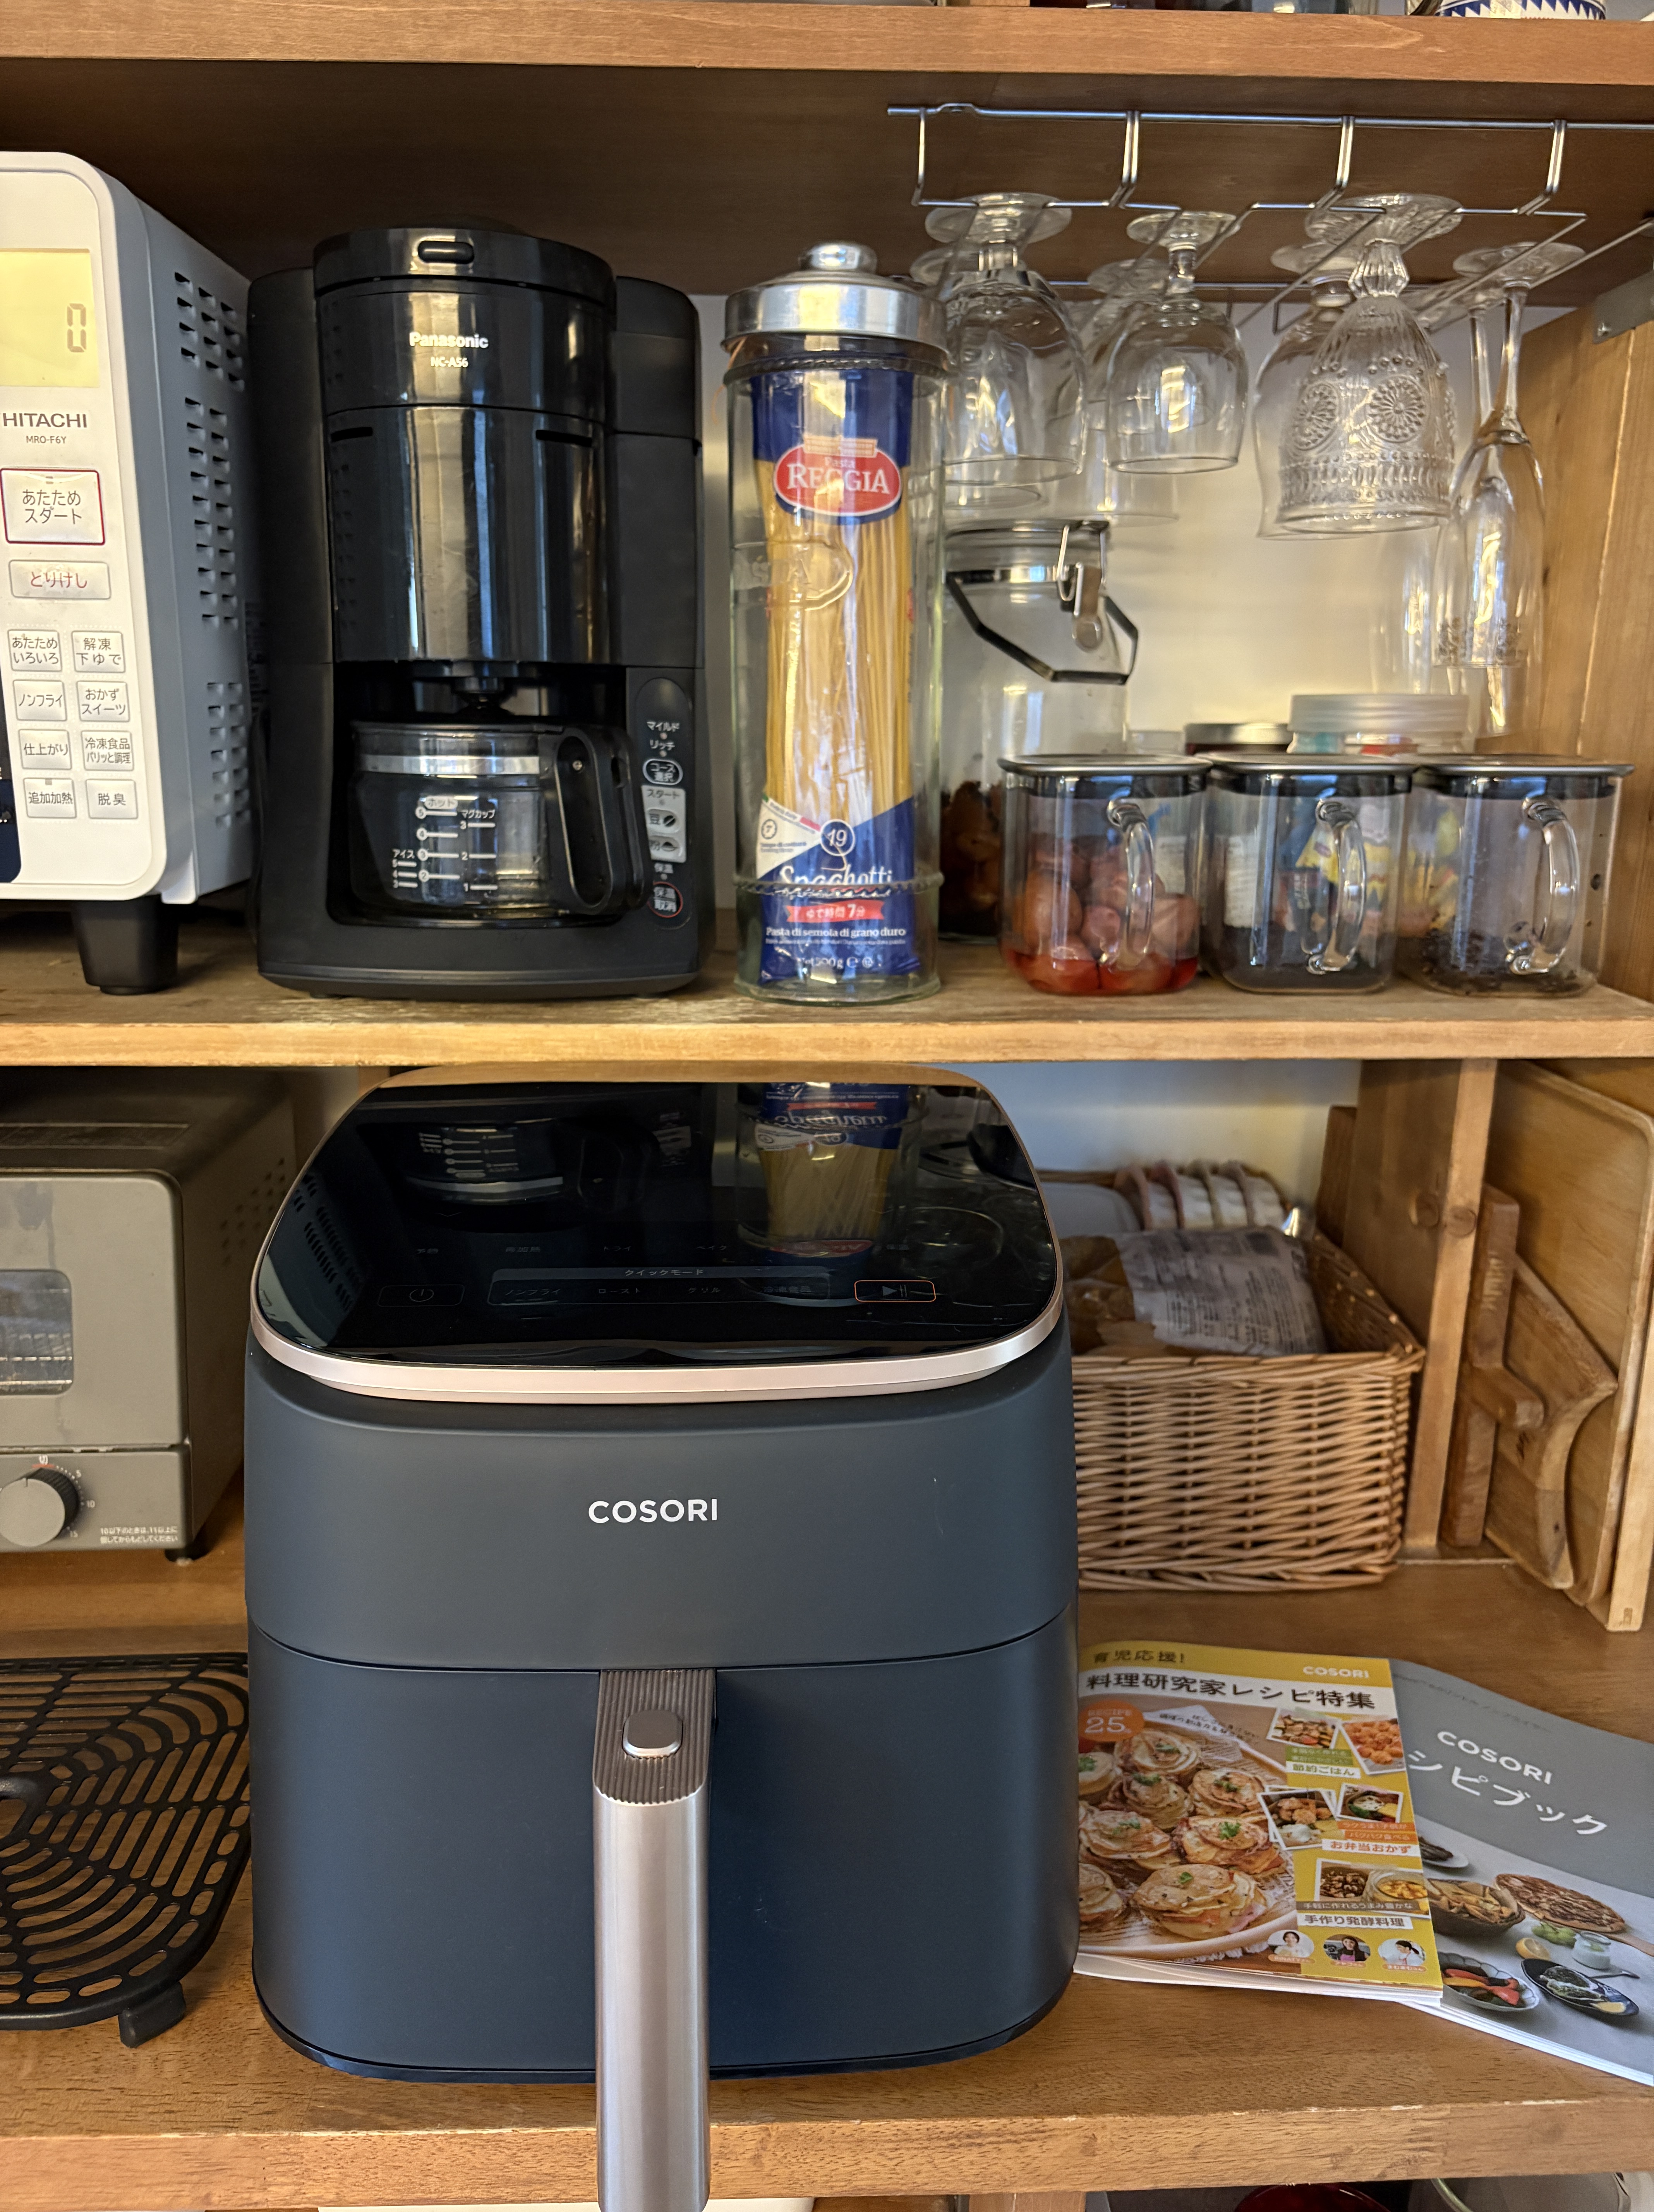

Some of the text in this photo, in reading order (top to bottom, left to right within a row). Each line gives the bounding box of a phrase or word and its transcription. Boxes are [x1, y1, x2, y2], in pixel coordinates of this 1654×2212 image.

[67, 303, 86, 352] 0
[410, 331, 489, 349] Panasonic
[431, 356, 468, 368] NC-A56
[3, 413, 87, 428] HITACHI
[26, 435, 66, 444] MRO-F6Y
[787, 463, 890, 495] REGGIA
[22, 490, 81, 507] あたため
[25, 508, 82, 524] スタート
[30, 572, 88, 588] とりけし
[12, 637, 57, 649] あたため
[84, 638, 111, 650] 解凍
[13, 652, 59, 664] いろいろ
[76, 653, 121, 665] 下ゆで
[19, 694, 62, 707] ノンフライ
[85, 689, 119, 701] おかず
[82, 704, 125, 715] スイーツ
[24, 743, 68, 756] 仕上がり
[85, 737, 130, 750] 冷凍食品
[650, 763, 676, 773] コース
[28, 791, 73, 804] 追加加熱
[98, 793, 126, 806] 脱臭
[647, 789, 679, 799] スタート
[428, 799, 455, 807] ホット
[461, 809, 495, 819] マグカップ
[460, 820, 467, 830] 3
[825, 829, 847, 847] 19
[461, 852, 468, 860] 2
[463, 883, 468, 891] 1
[766, 927, 906, 939] Pasta di semola di grano duro
[625, 1268, 703, 1276] クイックモード
[505, 1288, 561, 1296] ノンフライ
[86, 1500, 95, 1508] 10
[588, 1499, 717, 1523] COSORI
[1302, 1666, 1369, 1679] COSORI
[1086, 1672, 1376, 1709] 料理研究家レシピ特集
[1085, 1716, 1126, 1734] 25
[1437, 1731, 1553, 1785] COSORI
[1330, 1841, 1411, 1853] お弁当おかず
[1304, 1915, 1405, 1927] 手作り発酵料理
